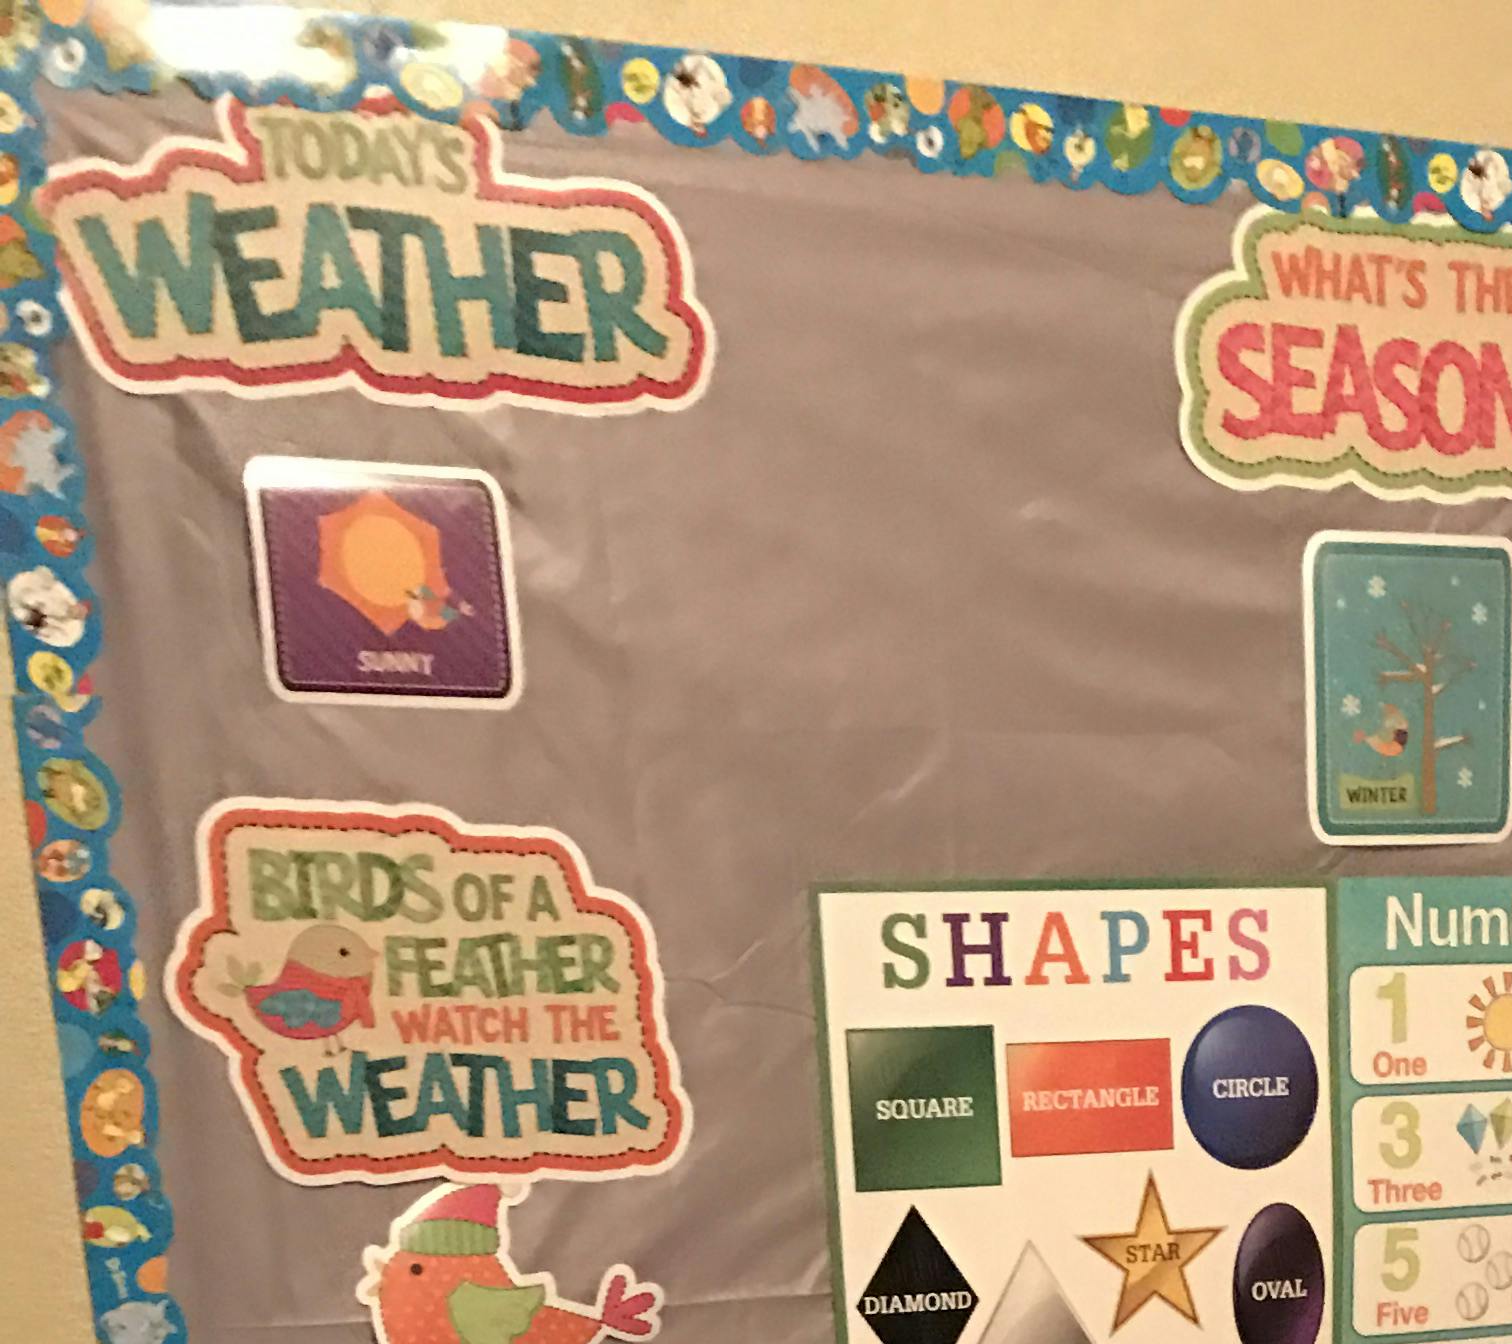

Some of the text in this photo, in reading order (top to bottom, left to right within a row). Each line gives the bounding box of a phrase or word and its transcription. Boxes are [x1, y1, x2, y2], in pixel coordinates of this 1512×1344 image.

[256, 114, 470, 195] TODAY'S
[75, 194, 669, 364] WEATHER
[1271, 247, 1427, 311] WHAT'S
[356, 650, 434, 677] SUNNY
[1345, 785, 1408, 805] WINTER
[246, 848, 561, 922] BIRDS OF A
[383, 933, 620, 999] FEATHER
[881, 908, 1270, 990] SHAPES
[391, 1003, 619, 1045] WATCH THE
[1376, 971, 1408, 1044] 1
[1372, 1052, 1427, 1078] One
[279, 1049, 651, 1140] WEATHER
[1022, 1085, 1160, 1113] RECTANGLE
[1212, 1076, 1289, 1099] CIRCLE
[875, 1096, 974, 1121] SQUARE
[1379, 1101, 1422, 1169] 3
[1368, 1178, 1442, 1205] Three
[1126, 1242, 1181, 1264] STAR
[1381, 1227, 1421, 1292] 5
[863, 1290, 972, 1317] DIAMOND
[1251, 1278, 1308, 1301] OVAL
[1375, 1302, 1429, 1326] Five
